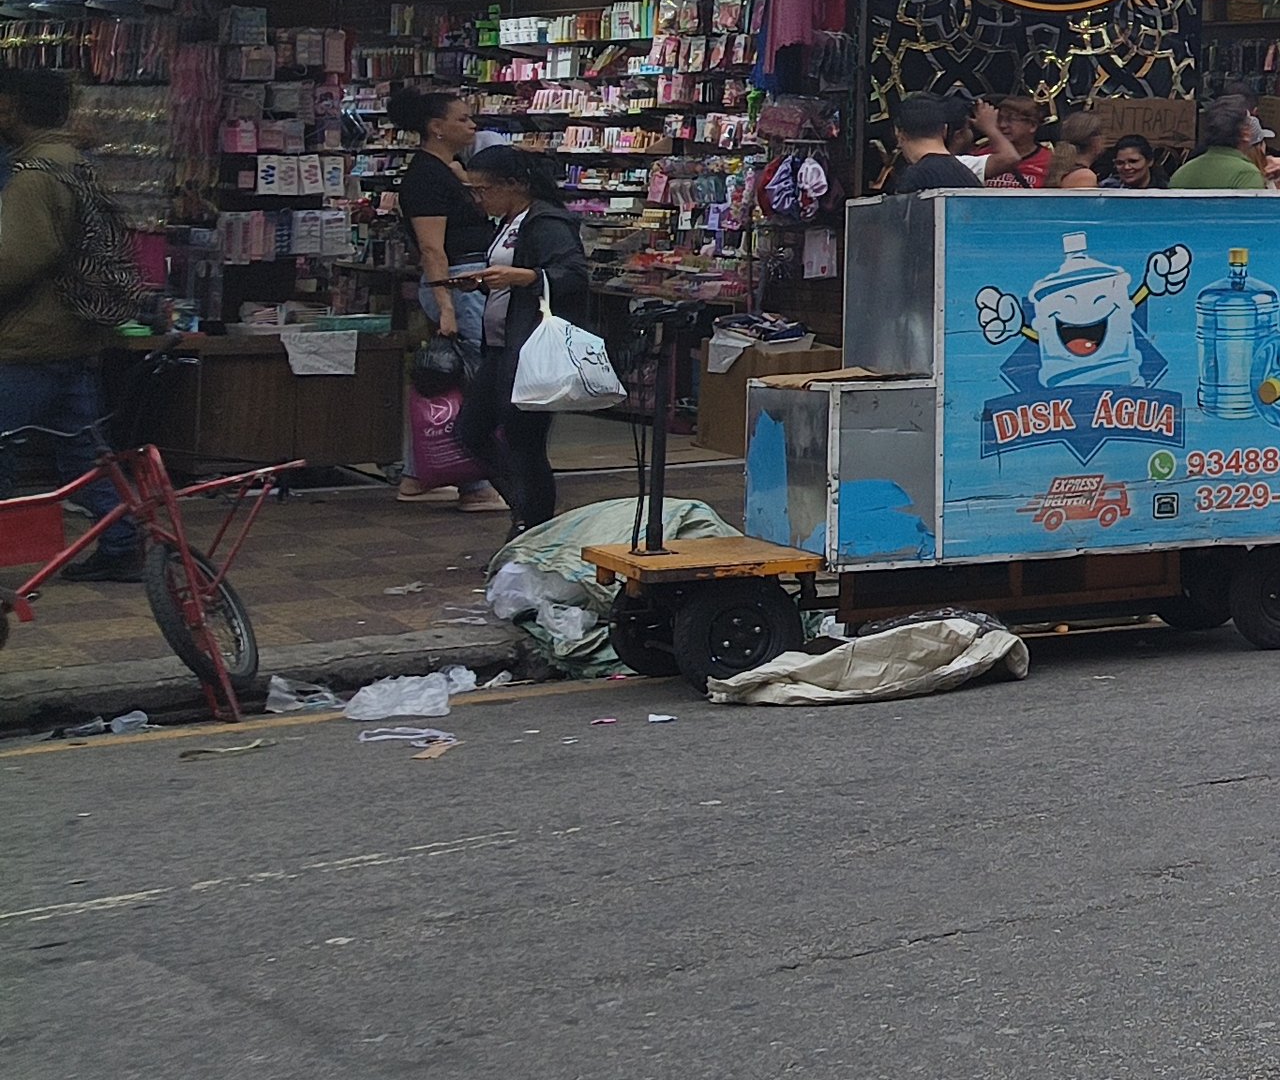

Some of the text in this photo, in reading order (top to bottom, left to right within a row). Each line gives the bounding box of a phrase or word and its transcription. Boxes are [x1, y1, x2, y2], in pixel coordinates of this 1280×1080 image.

[1096, 103, 1190, 133] ENTRADA
[992, 390, 1176, 444] DISK ÁGUA
[1051, 478, 1101, 493] EXPRESS
